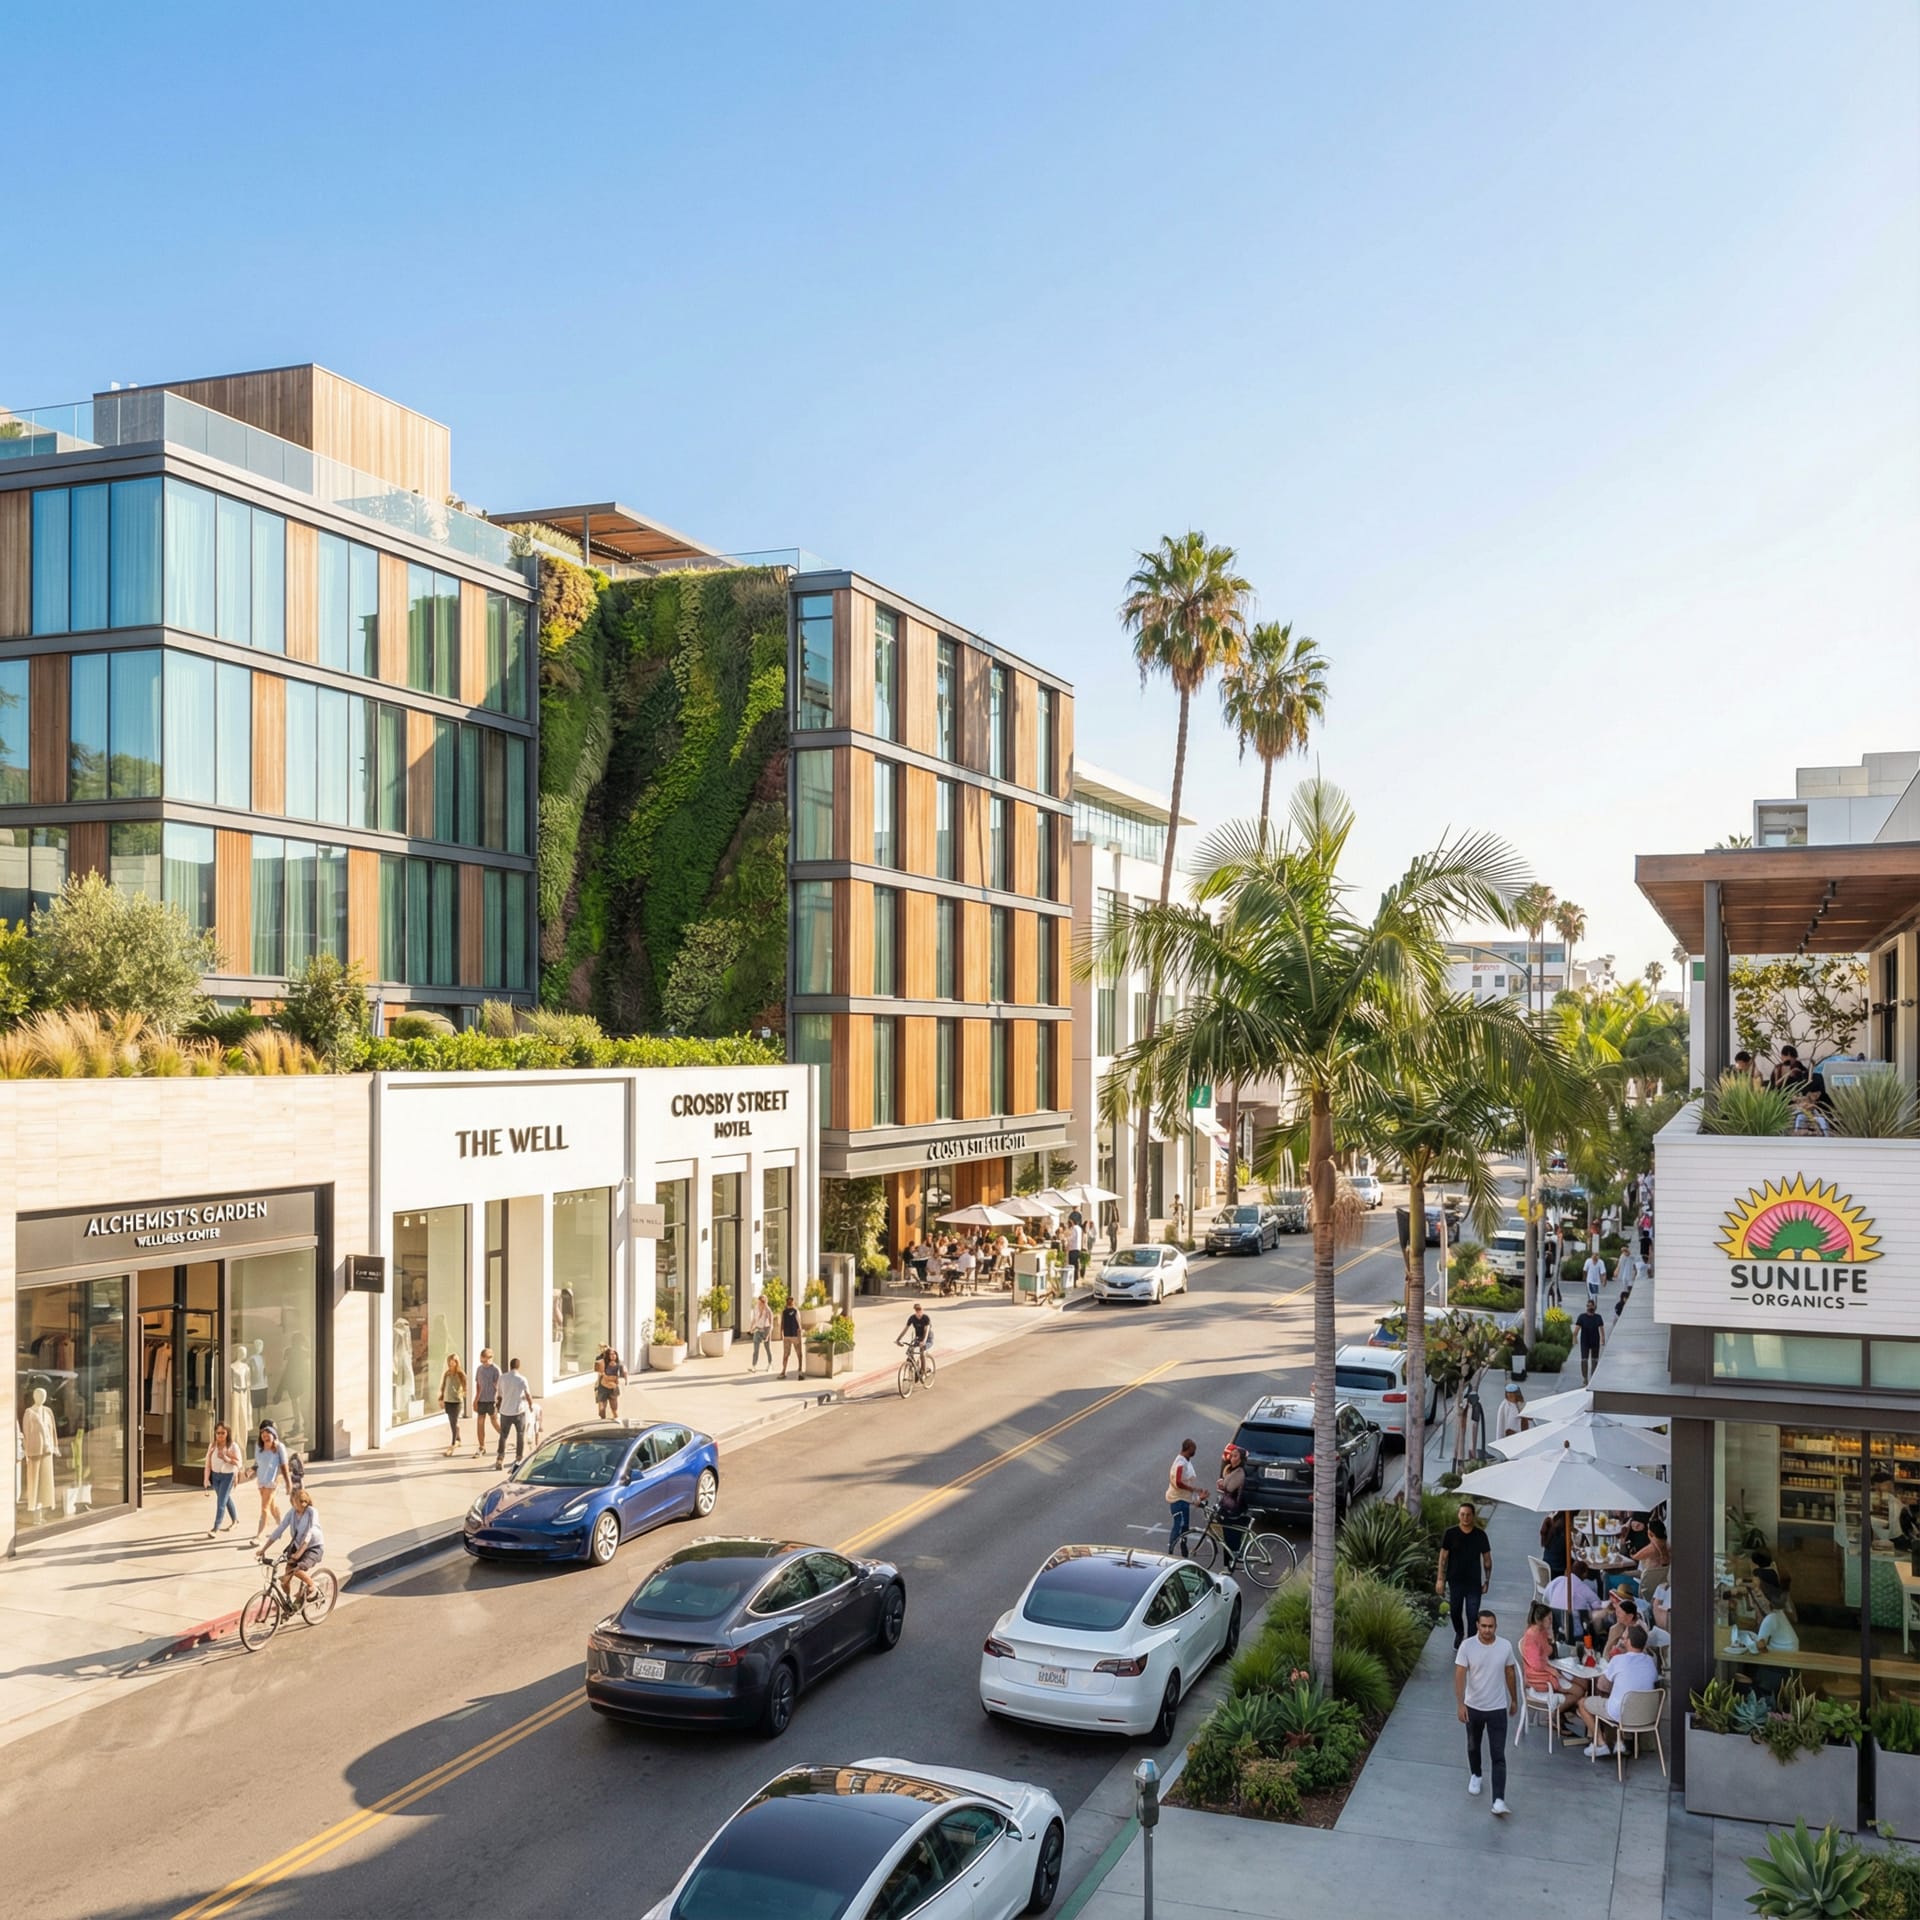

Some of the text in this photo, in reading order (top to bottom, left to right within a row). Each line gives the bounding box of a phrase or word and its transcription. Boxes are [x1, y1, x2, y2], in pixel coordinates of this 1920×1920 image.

[671, 1089, 789, 1118] CROSBY STREET
[455, 1124, 569, 1159] THE WELL
[714, 1120, 752, 1139] HOTEL
[86, 1200, 268, 1237] ALCHEMIST'S GARDEN
[1730, 1264, 1868, 1293] SUNLIFE
[1751, 1293, 1846, 1309] ORGANICS
